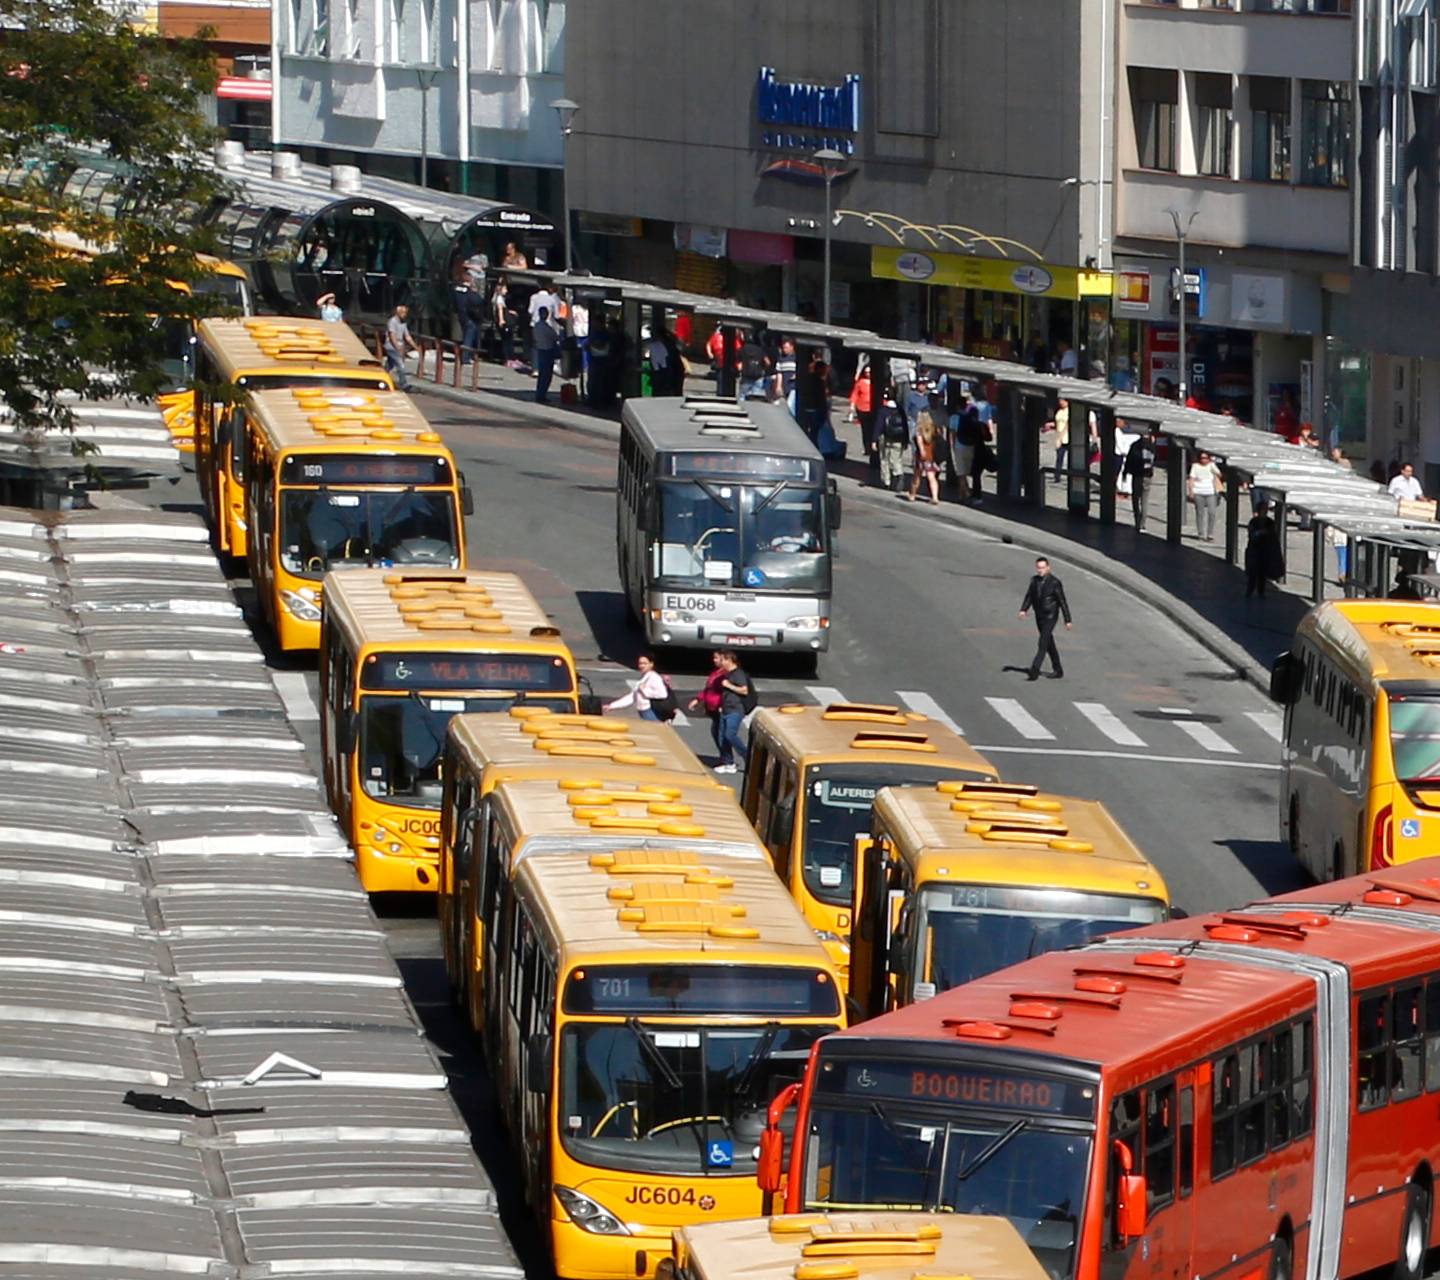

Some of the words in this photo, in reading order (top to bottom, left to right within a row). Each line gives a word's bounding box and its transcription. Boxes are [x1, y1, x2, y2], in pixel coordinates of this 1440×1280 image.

[666, 596, 717, 612] EL068
[431, 661, 468, 680] VILA
[475, 661, 530, 681] VELHA
[831, 786, 876, 800] ALFERES
[600, 979, 630, 997] 701
[625, 1186, 698, 1207] JC604
